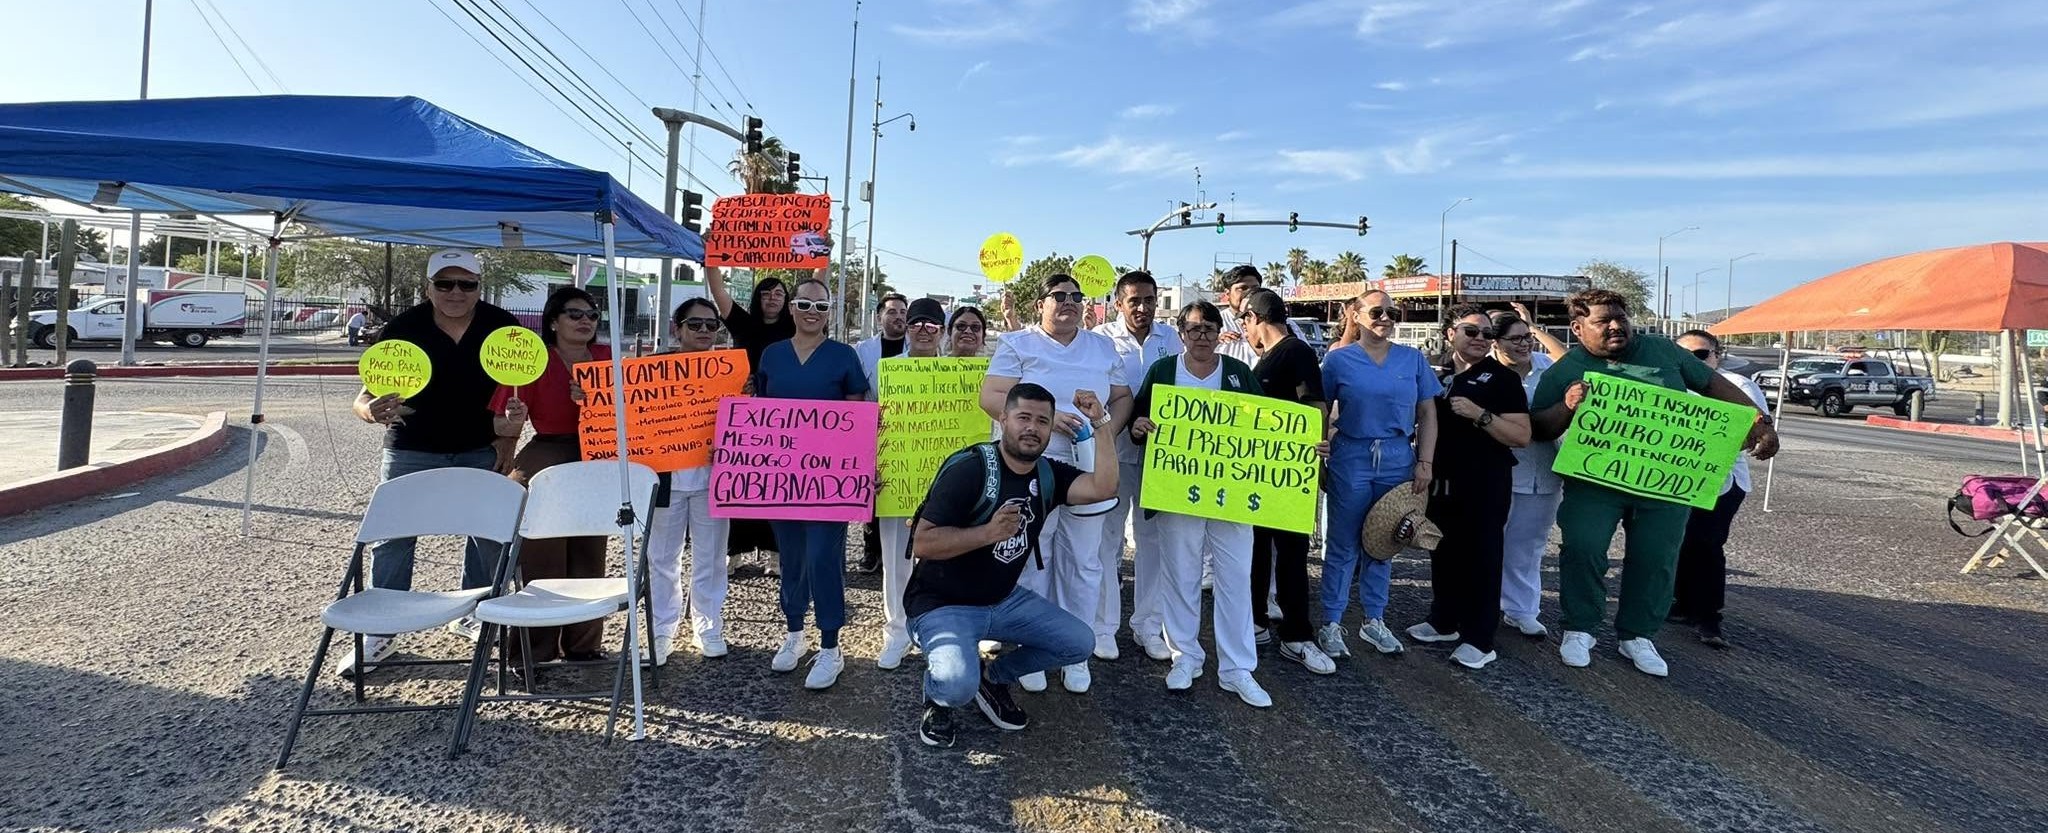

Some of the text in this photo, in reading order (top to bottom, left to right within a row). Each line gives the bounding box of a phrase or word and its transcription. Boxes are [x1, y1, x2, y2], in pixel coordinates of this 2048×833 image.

[717, 196, 830, 208] AMBULANCIAS
[712, 207, 811, 218] SEGURAS CON
[711, 220, 772, 231] DICTAMEN
[711, 233, 790, 250] Y PERSONAL
[1468, 276, 1520, 290] LLANTERA
[380, 342, 412, 357] #SIN
[486, 344, 540, 364] INSUMOS/
[370, 358, 421, 373] PAGO PARA
[486, 358, 537, 375] MATERIALES
[575, 356, 734, 389] MEDICAMENTOS
[365, 370, 422, 388] SUPLENTES
[906, 399, 974, 416] MEDICAMENTOS
[1588, 377, 1730, 423] NO HAY INSUMOS
[1591, 398, 1607, 410] NI
[728, 402, 854, 432] EXIGIMOS
[1159, 392, 1307, 434] ¿DONDE ESTA
[908, 418, 960, 434] MATERIALES
[1578, 410, 1706, 457] QUIERO DAR
[722, 430, 798, 450] MESA DE
[911, 436, 967, 453] UNIFORMES
[1154, 424, 1317, 465] EL PRESUPUESTO
[587, 447, 653, 460] SOLUCONES
[660, 440, 703, 454] SALINAS
[714, 448, 861, 470] DIALOGO CON EL
[1577, 432, 1720, 474] UNA ATENCION DE
[1153, 448, 1315, 494] PARA LA SALUD?
[1583, 452, 1707, 498] CALIDAD!
[714, 471, 871, 503] GOBERNADOR
[997, 533, 1025, 551] MBM
